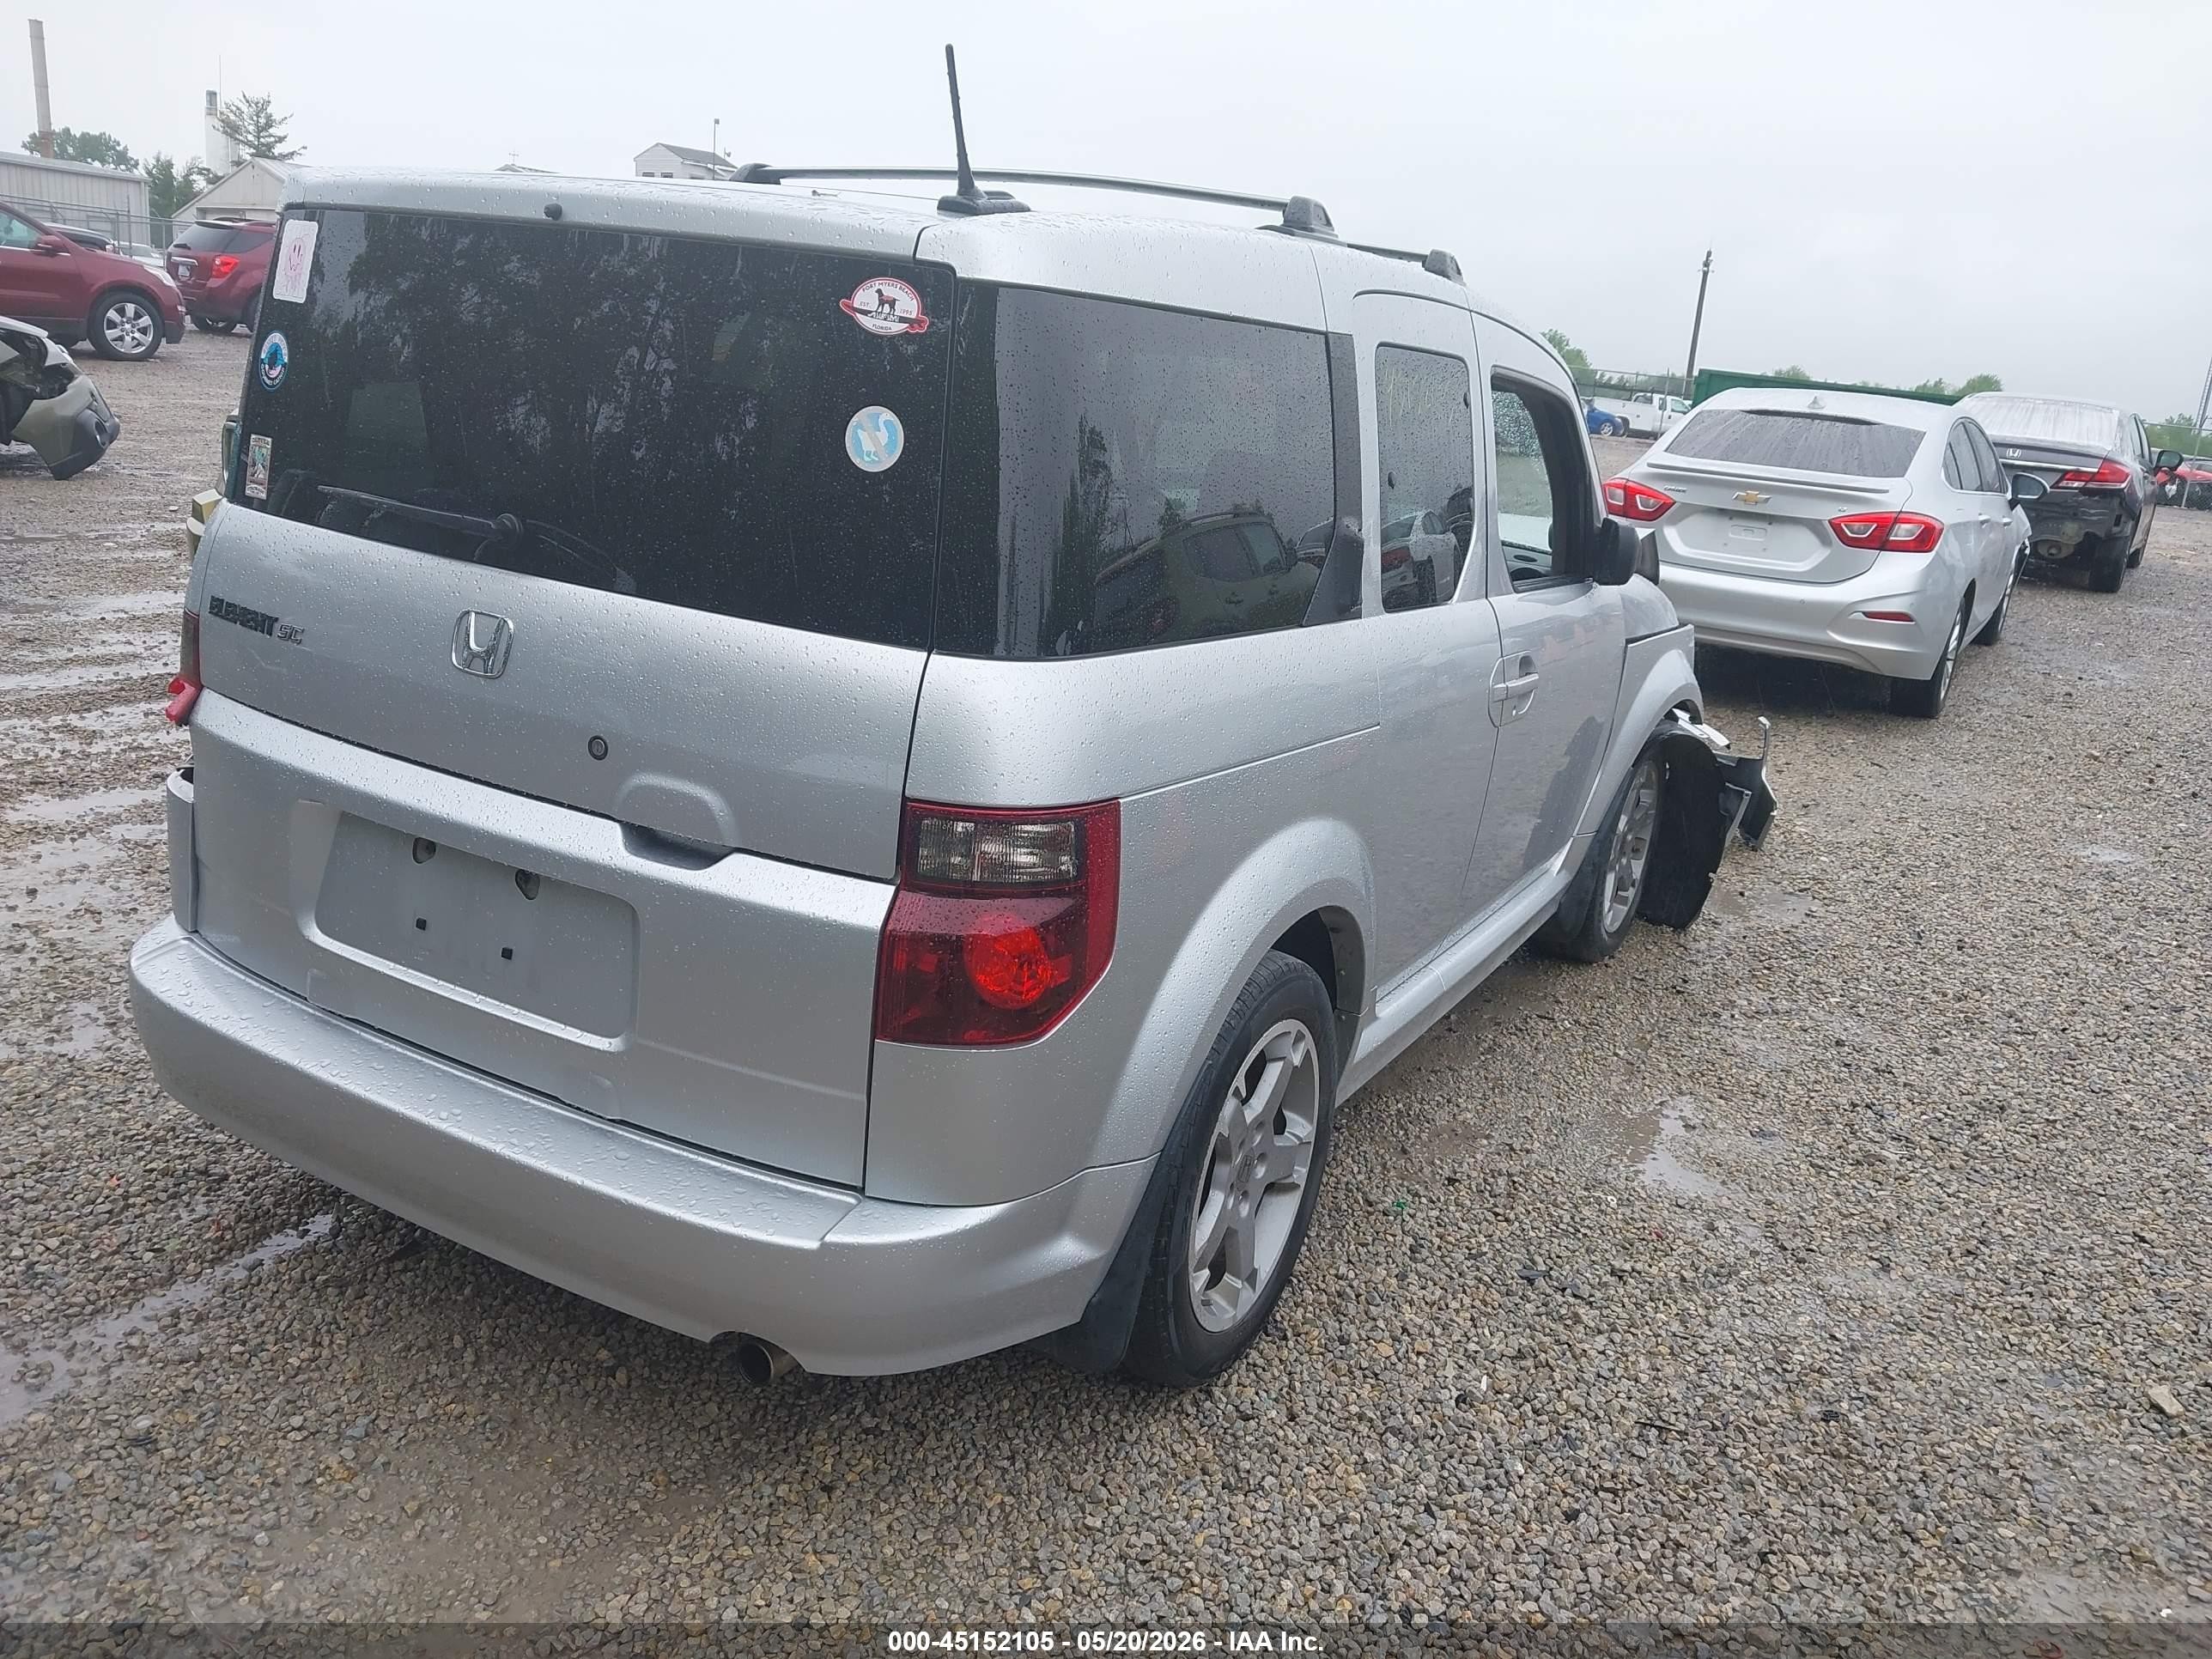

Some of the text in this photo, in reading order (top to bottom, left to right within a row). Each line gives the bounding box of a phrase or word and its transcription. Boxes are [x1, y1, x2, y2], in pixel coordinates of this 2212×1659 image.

[862, 282, 877, 293] FORT
[898, 286, 915, 302] BEACH
[209, 595, 305, 646] ELEMENT SC
